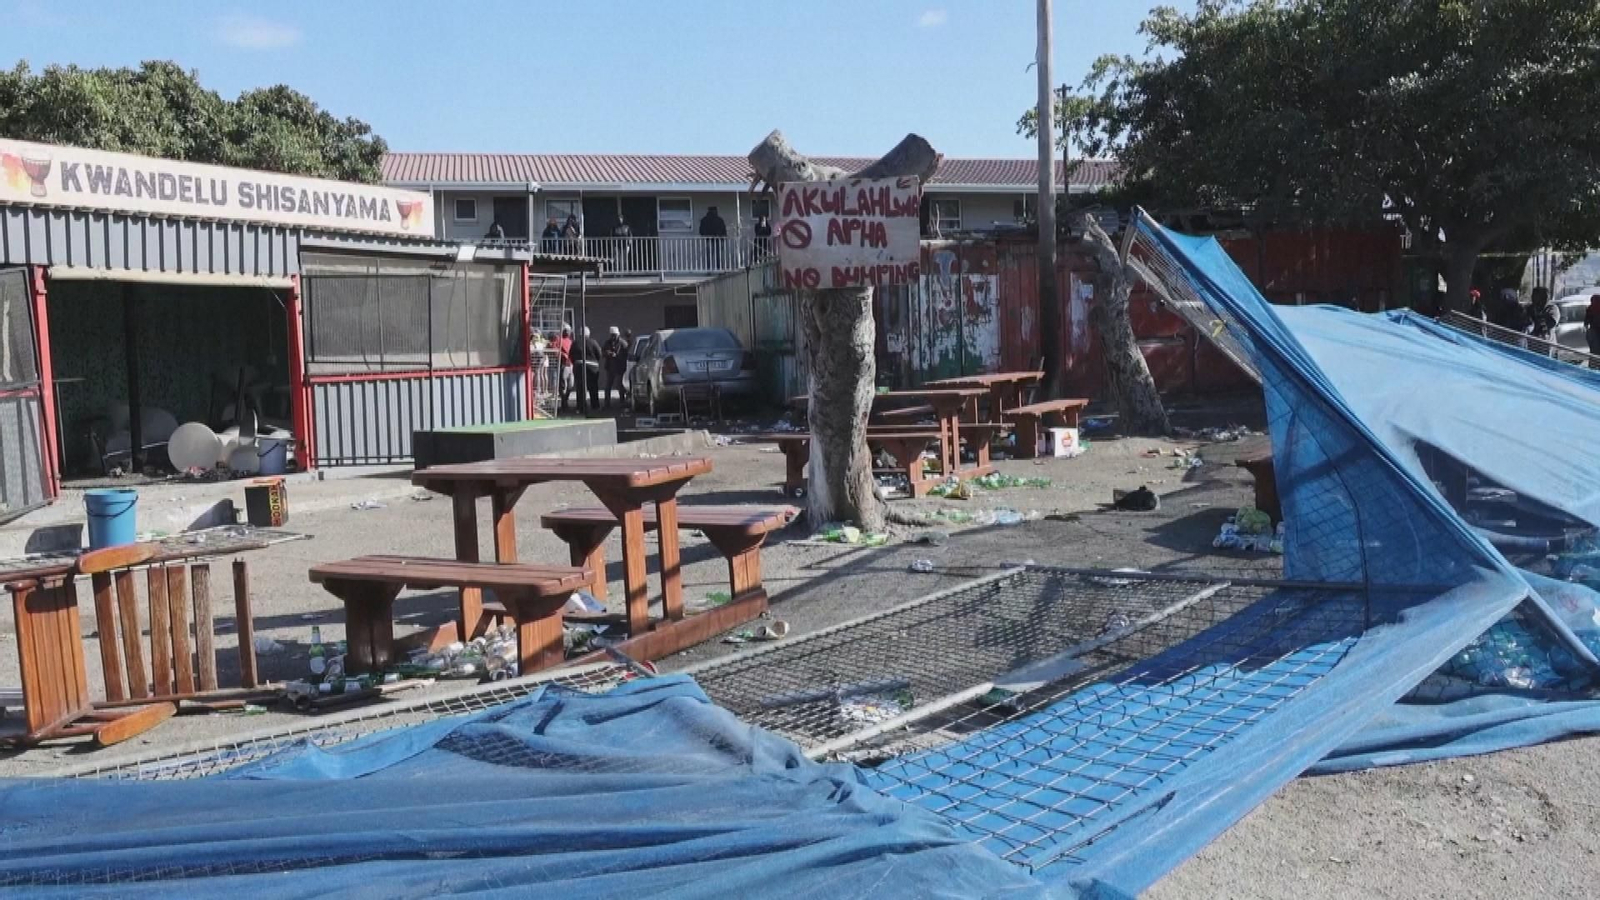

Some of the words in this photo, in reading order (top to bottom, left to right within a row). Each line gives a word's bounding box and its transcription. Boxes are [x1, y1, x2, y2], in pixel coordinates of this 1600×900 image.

[60, 161, 229, 206] KWANDELU
[238, 181, 392, 223] SHISANYAMA
[784, 267, 821, 289] NO
[831, 262, 919, 288] DUMPING
